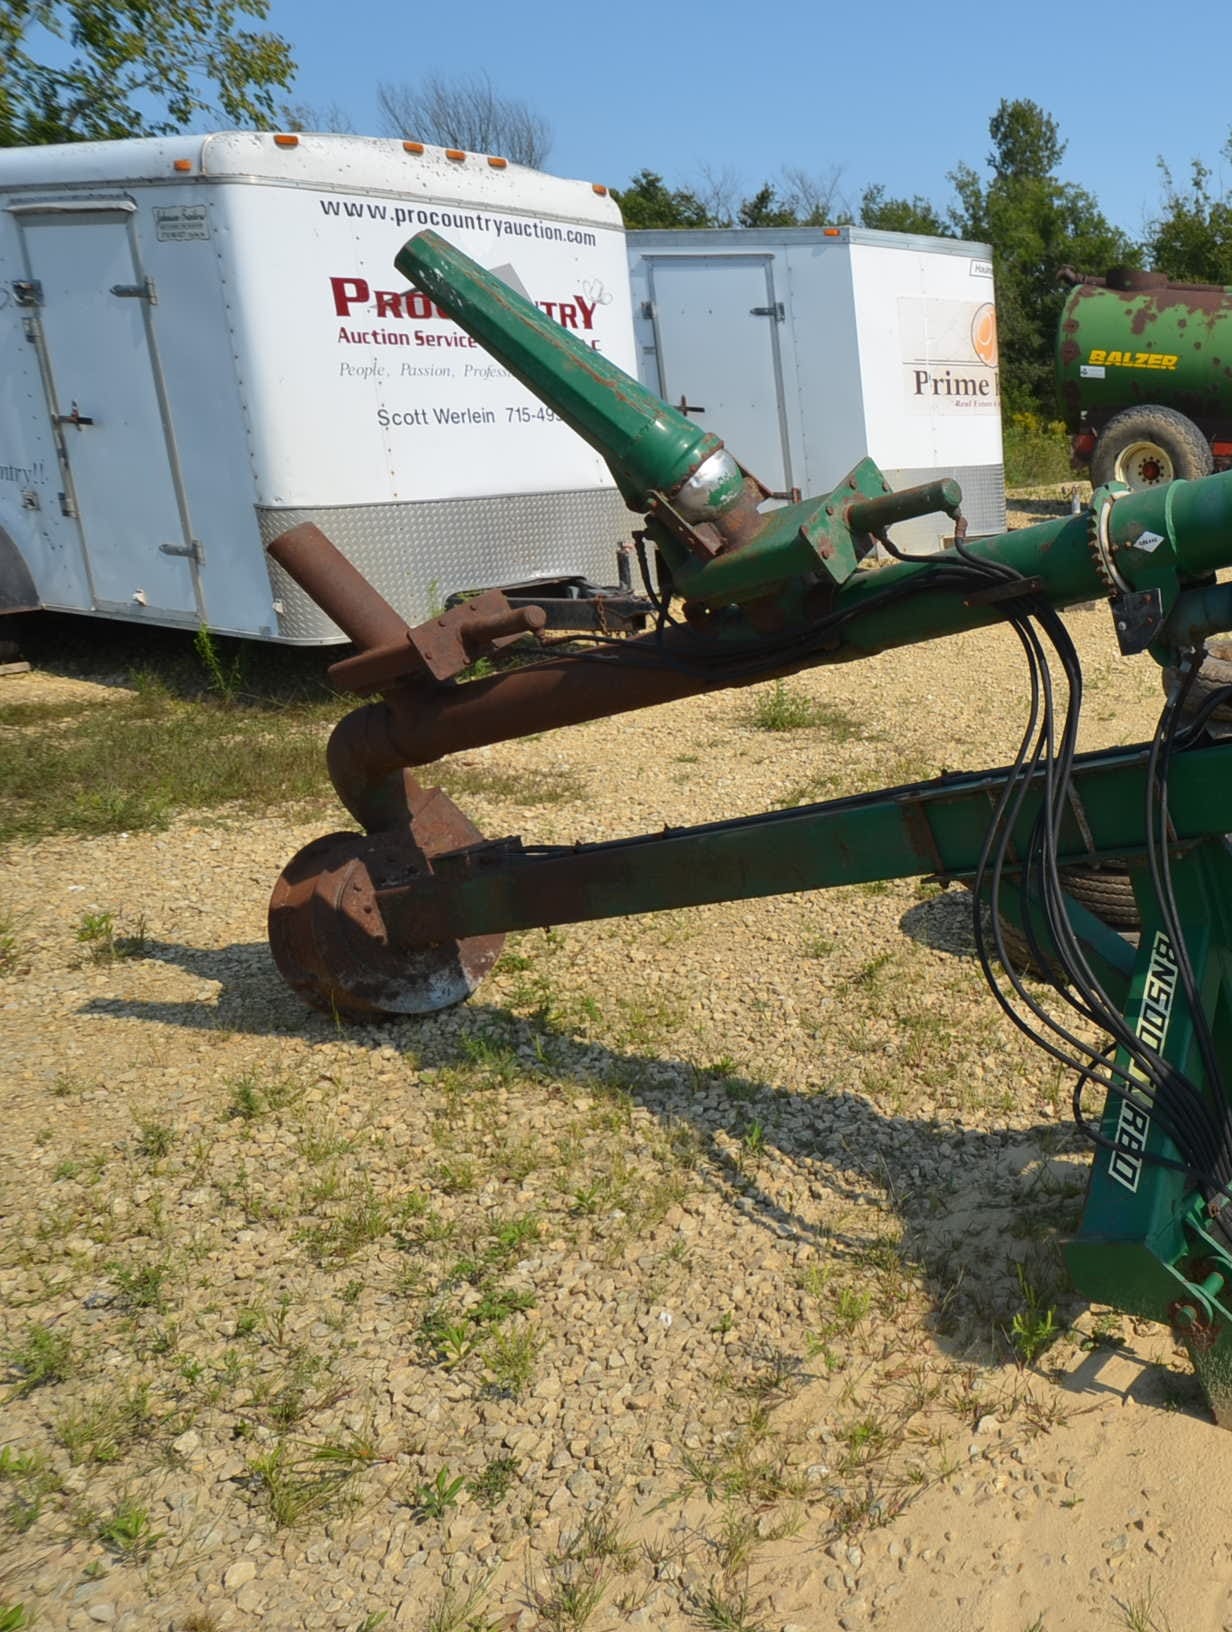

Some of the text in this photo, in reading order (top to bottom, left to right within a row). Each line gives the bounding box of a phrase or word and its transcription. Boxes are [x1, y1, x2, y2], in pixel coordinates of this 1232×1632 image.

[319, 199, 597, 248] www.procountryauction.com
[329, 276, 597, 330] PROTRY
[337, 326, 411, 346] Auction
[1088, 349, 1179, 371] BALZER
[339, 362, 511, 381] People, Passion, Profess
[912, 369, 991, 397] Prime
[376, 406, 429, 427] Scott
[433, 406, 496, 426] Werlein
